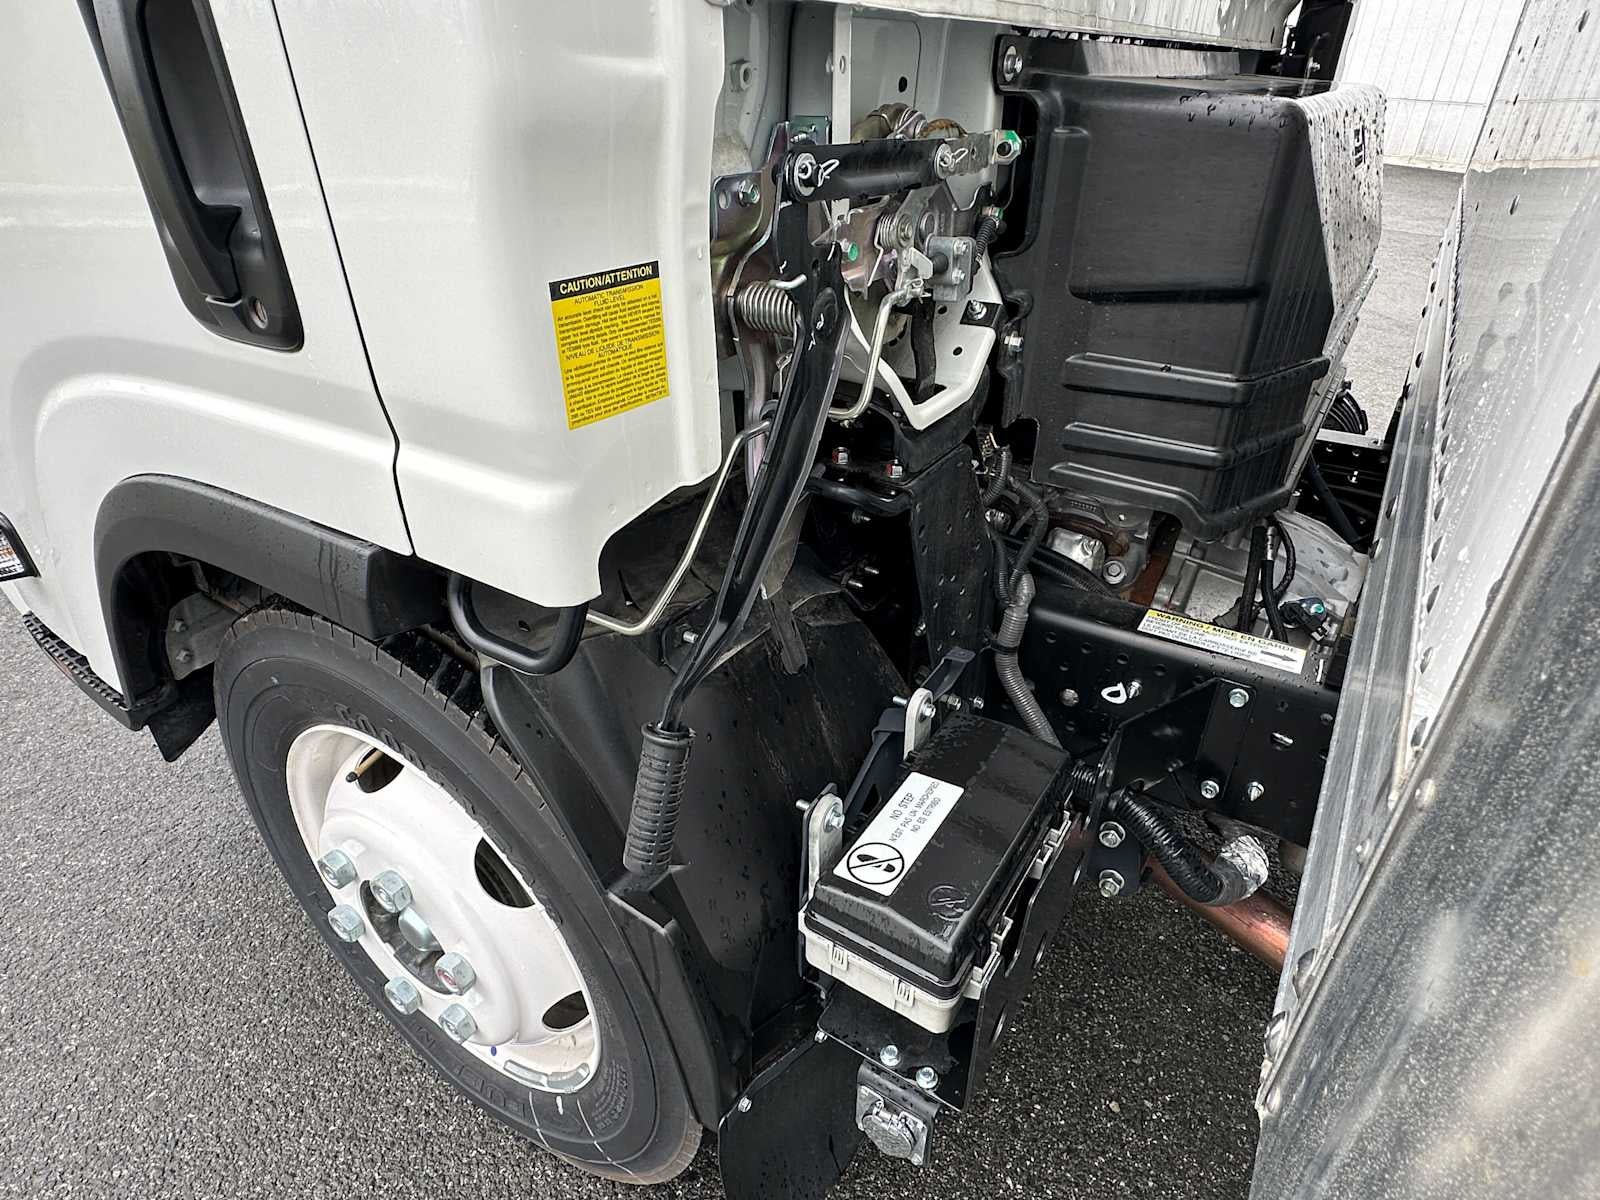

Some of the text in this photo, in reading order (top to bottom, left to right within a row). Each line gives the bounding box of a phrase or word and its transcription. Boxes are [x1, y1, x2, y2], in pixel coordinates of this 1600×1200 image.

[560, 265, 653, 294] CAUTION/ATTENTION
[574, 292, 604, 304] AUTOMATIC
[609, 294, 625, 302] LEVEL
[1156, 612, 1203, 627] WARNING
[1212, 627, 1237, 637] MISE
[1257, 639, 1296, 653] GARDE
[889, 792, 913, 820] NO STEP
[899, 817, 912, 827] PAS
[910, 824, 920, 832] NO
